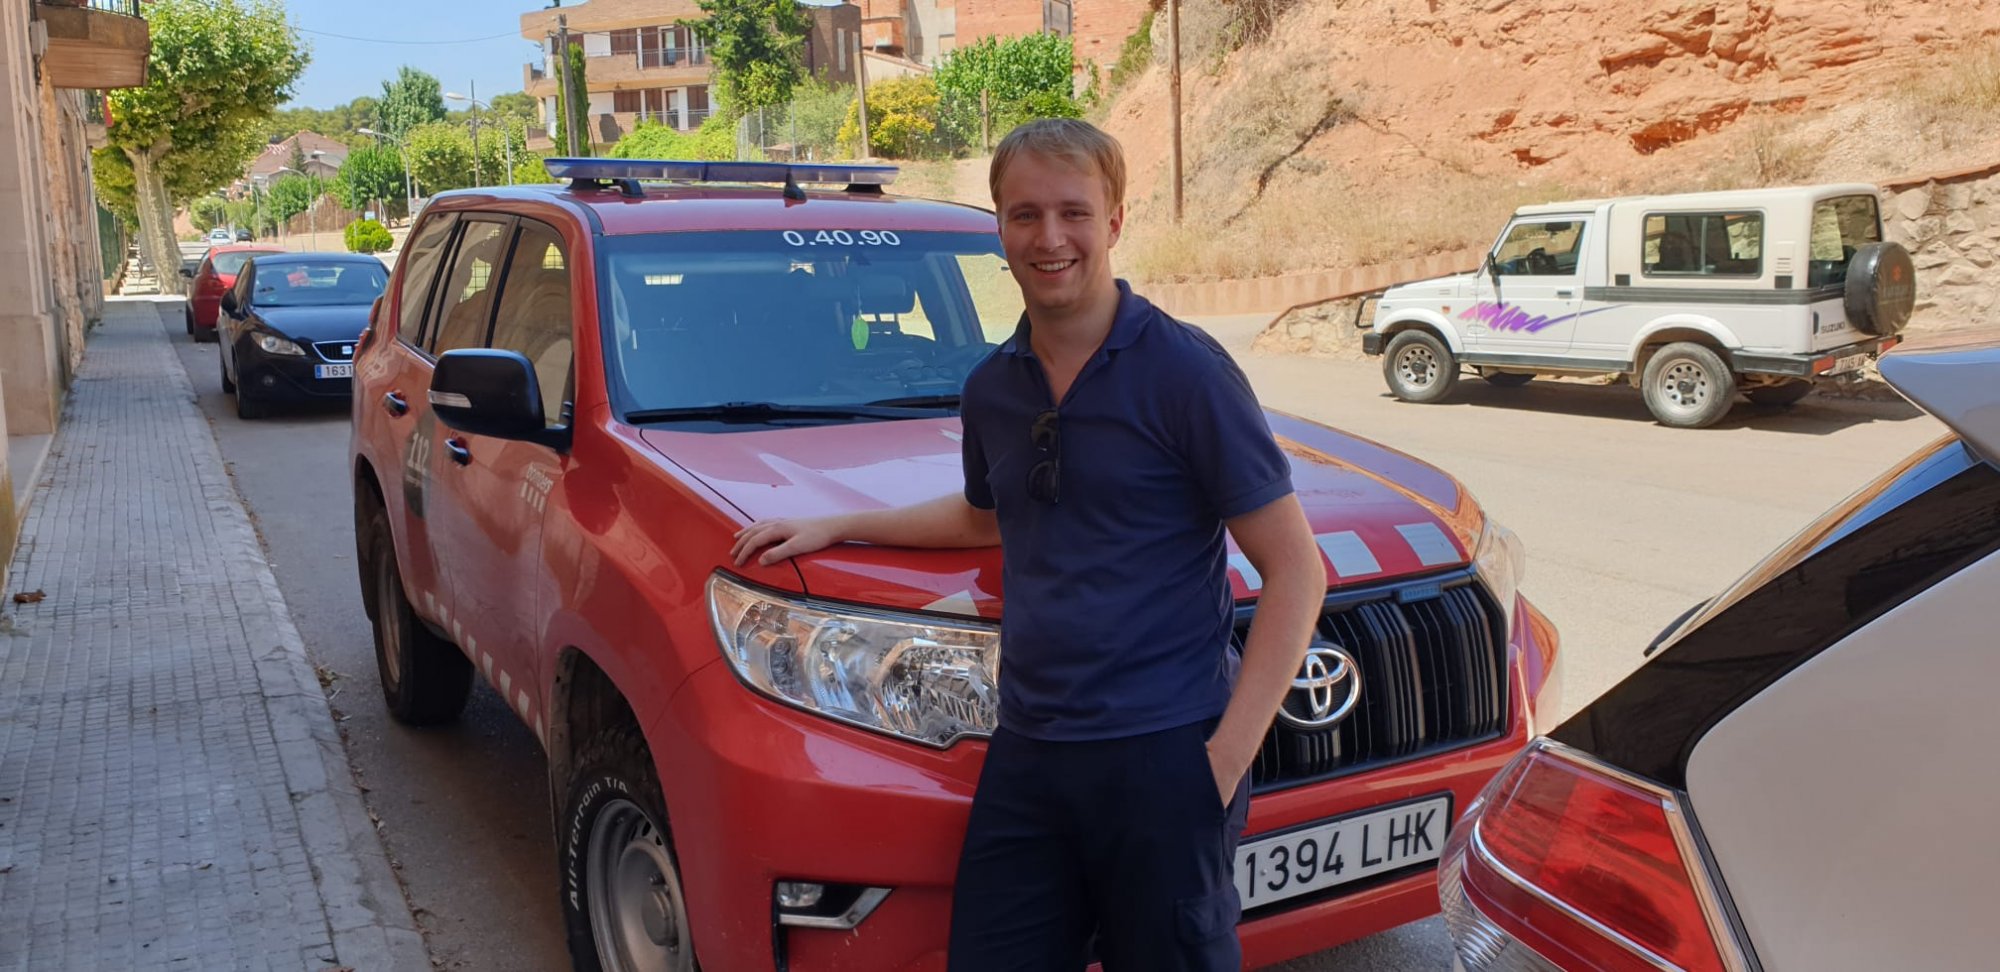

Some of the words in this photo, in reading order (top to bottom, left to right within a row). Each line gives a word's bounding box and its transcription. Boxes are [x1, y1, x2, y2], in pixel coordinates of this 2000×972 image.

[782, 230, 901, 246] 0.40.90
[1821, 321, 1845, 334] SUZUKI
[325, 365, 352, 377] 1631
[407, 432, 430, 475] 112
[568, 782, 601, 911] All-Terrain
[1245, 830, 1345, 899] 1394
[1361, 808, 1437, 868] LHK
